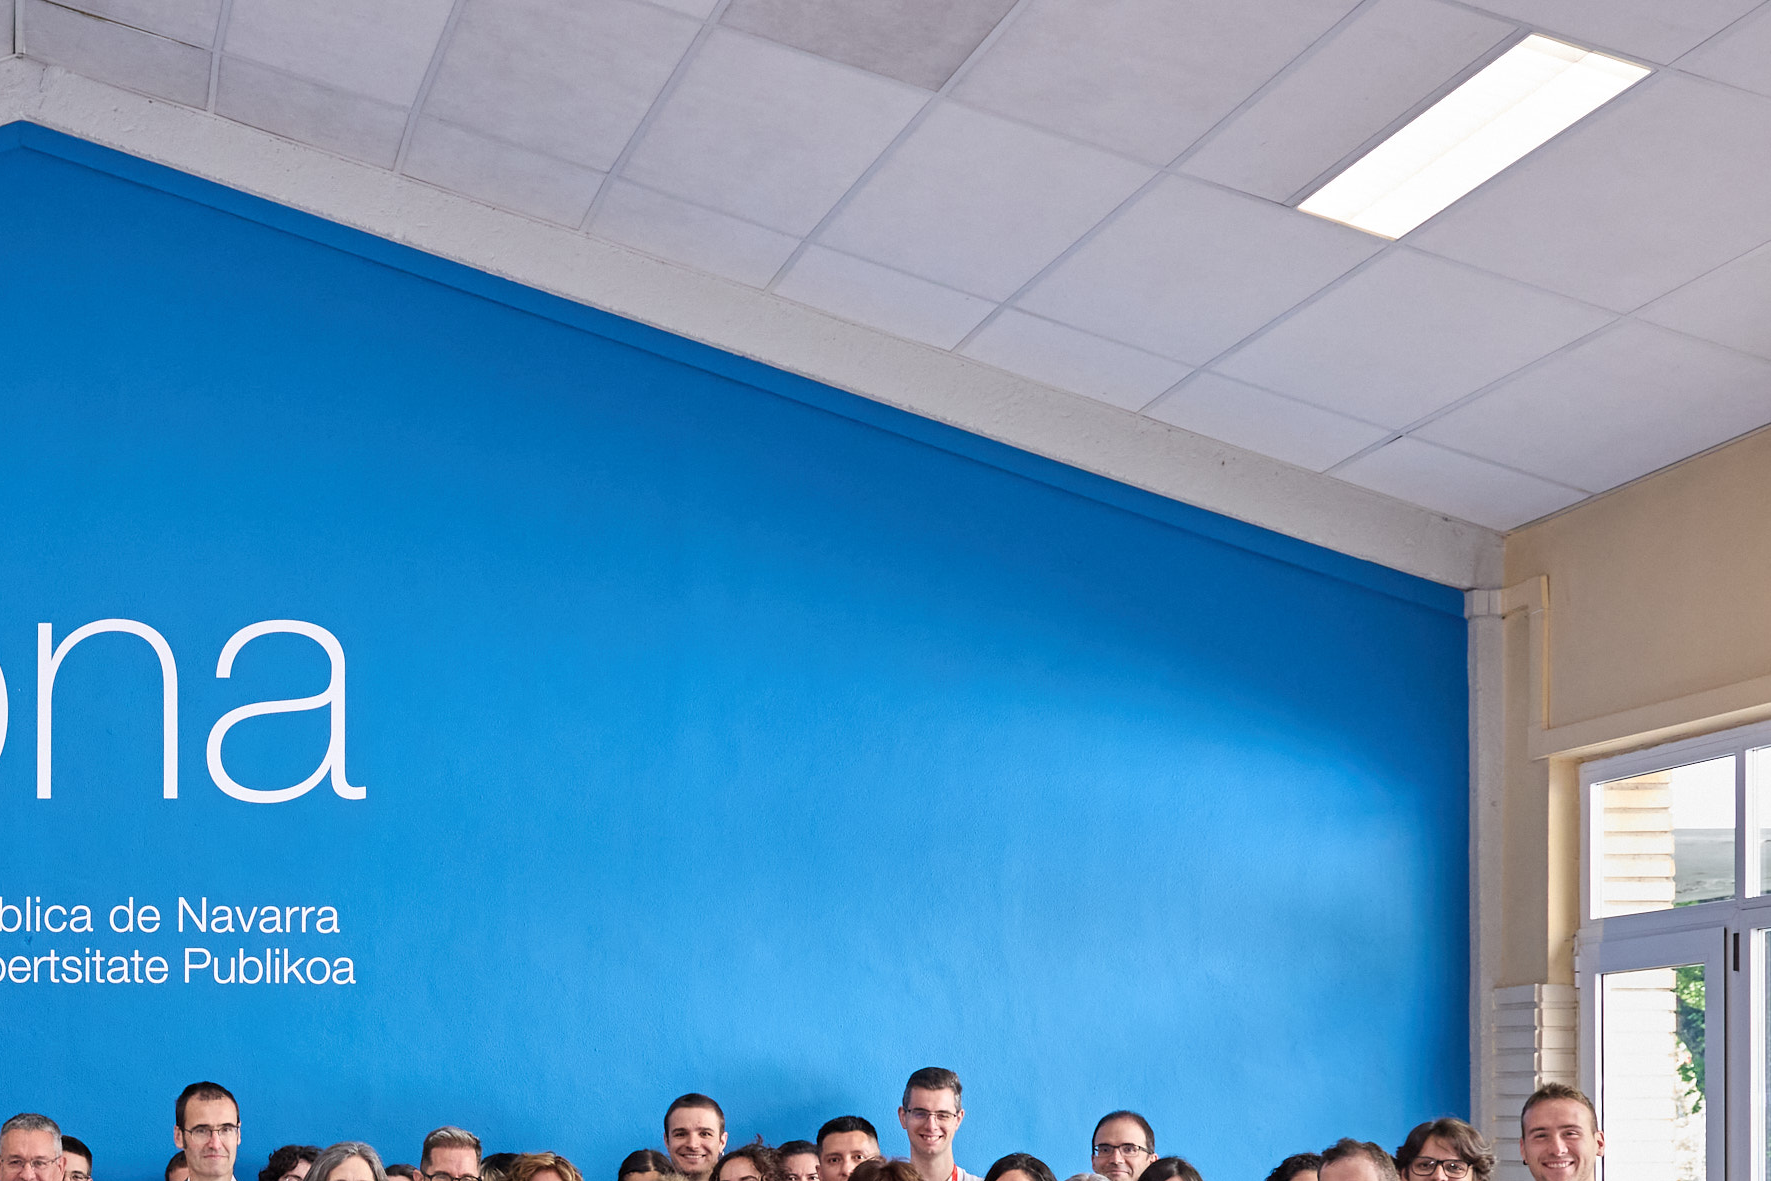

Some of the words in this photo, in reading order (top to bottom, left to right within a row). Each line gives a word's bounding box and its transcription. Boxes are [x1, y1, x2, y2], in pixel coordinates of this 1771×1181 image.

[109, 896, 161, 933] de
[178, 896, 341, 933] Navarra
[184, 947, 357, 985] Publikoa
